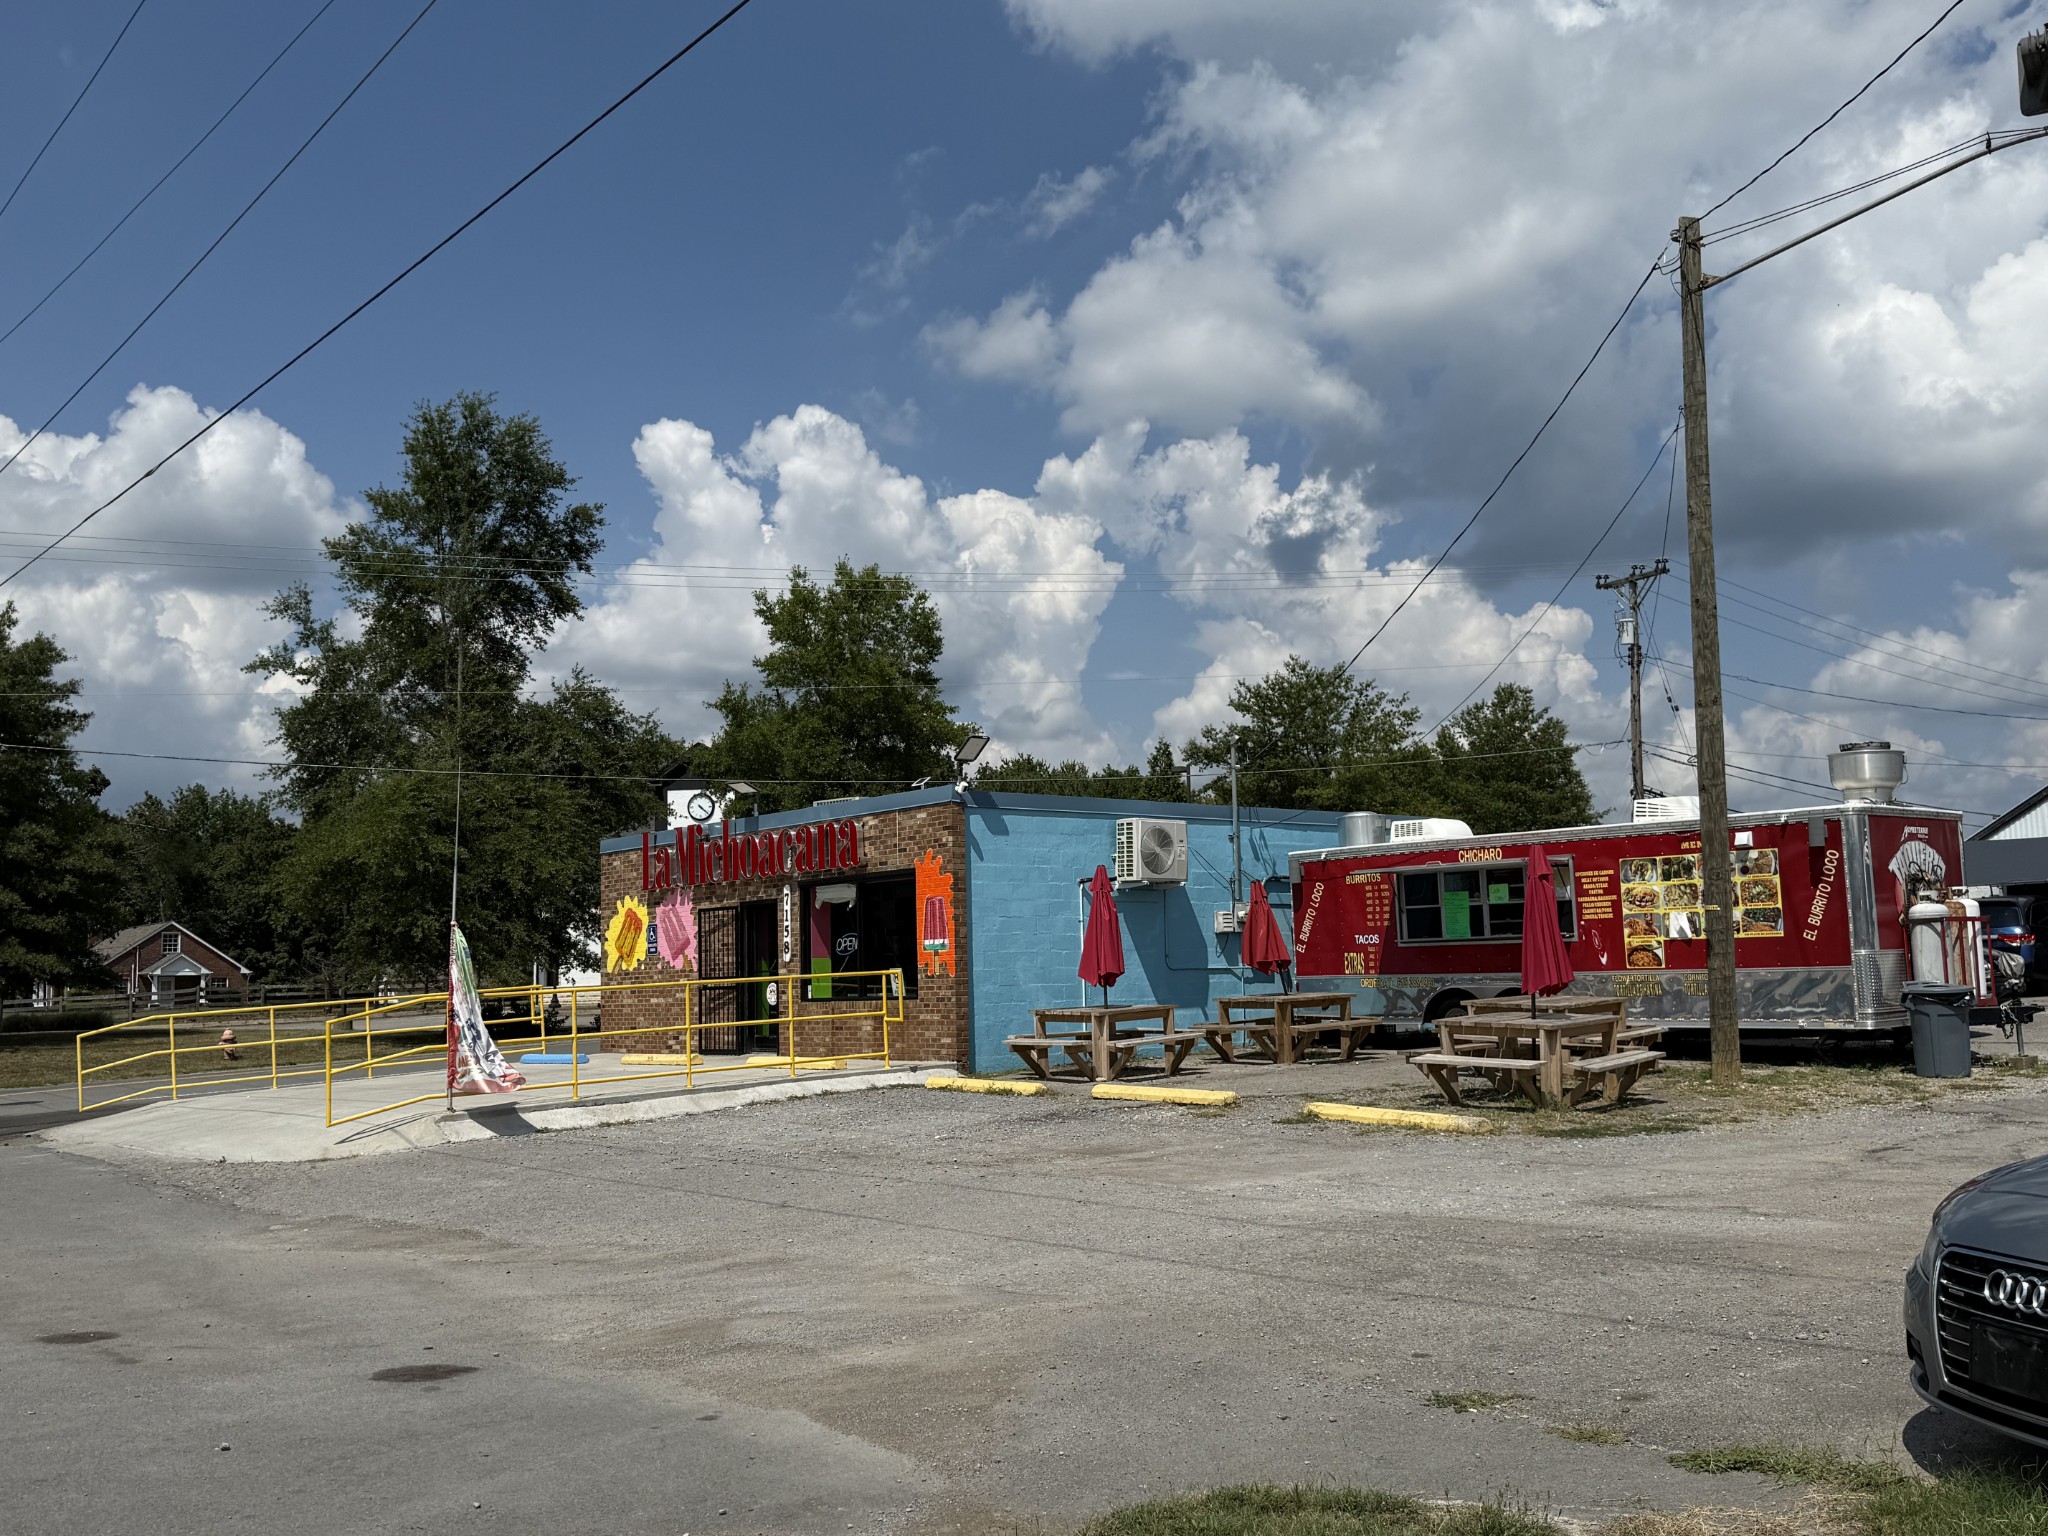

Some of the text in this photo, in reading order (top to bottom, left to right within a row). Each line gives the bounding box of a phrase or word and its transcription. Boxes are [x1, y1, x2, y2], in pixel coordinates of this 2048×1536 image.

[1680, 841, 1703, 850] MEN
[641, 819, 861, 891] La Michoacana
[1458, 848, 1503, 863] CHICHARO
[1345, 873, 1382, 885] BURRITOS
[1803, 849, 1840, 941] EL BURRITO LOCO
[1296, 882, 1325, 954] EL BURRITO LOCO
[836, 937, 859, 951] OPEN
[1354, 934, 1380, 945] TACOS
[1344, 952, 1365, 975] EXTRAS
